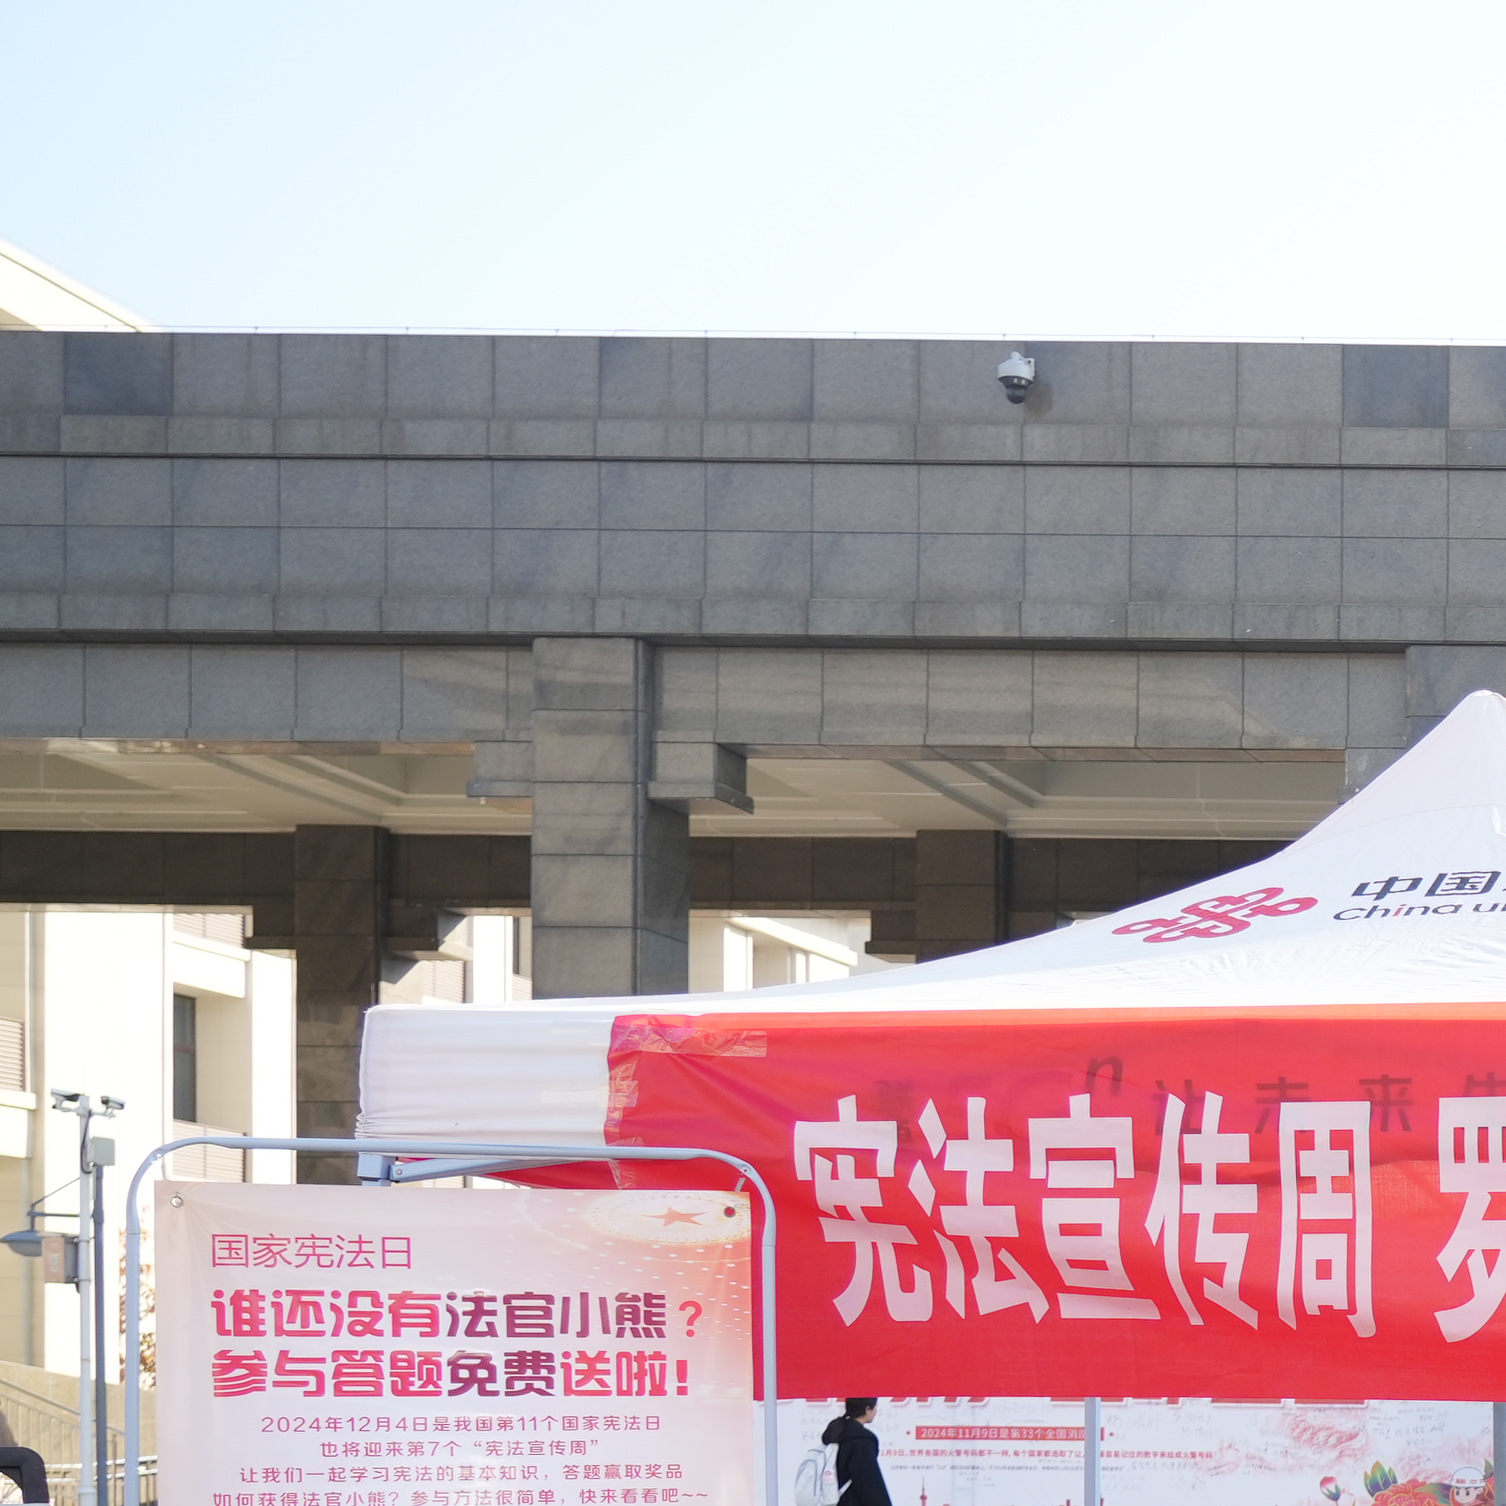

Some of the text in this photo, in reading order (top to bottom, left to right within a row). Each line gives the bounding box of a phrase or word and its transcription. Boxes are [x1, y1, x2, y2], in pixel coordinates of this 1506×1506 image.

[794, 1091, 1377, 1339] 宪法宣传周
[211, 1233, 412, 1270] 国家宪法日
[211, 1289, 703, 1340] 谁还没有法官小熊？
[211, 1349, 689, 1398] 参与答题免费送啦！
[261, 1414, 662, 1435] 2024年12月4日是我国第11个国家宪法日
[921, 1427, 1085, 1440] 2024年11月9日是第33个全国消
[320, 1438, 600, 1459] 也将迎来第7个“宪法宣传周”
[240, 1462, 683, 1484] 让我们一起学习宪法的基本知识，答题赢取奖品
